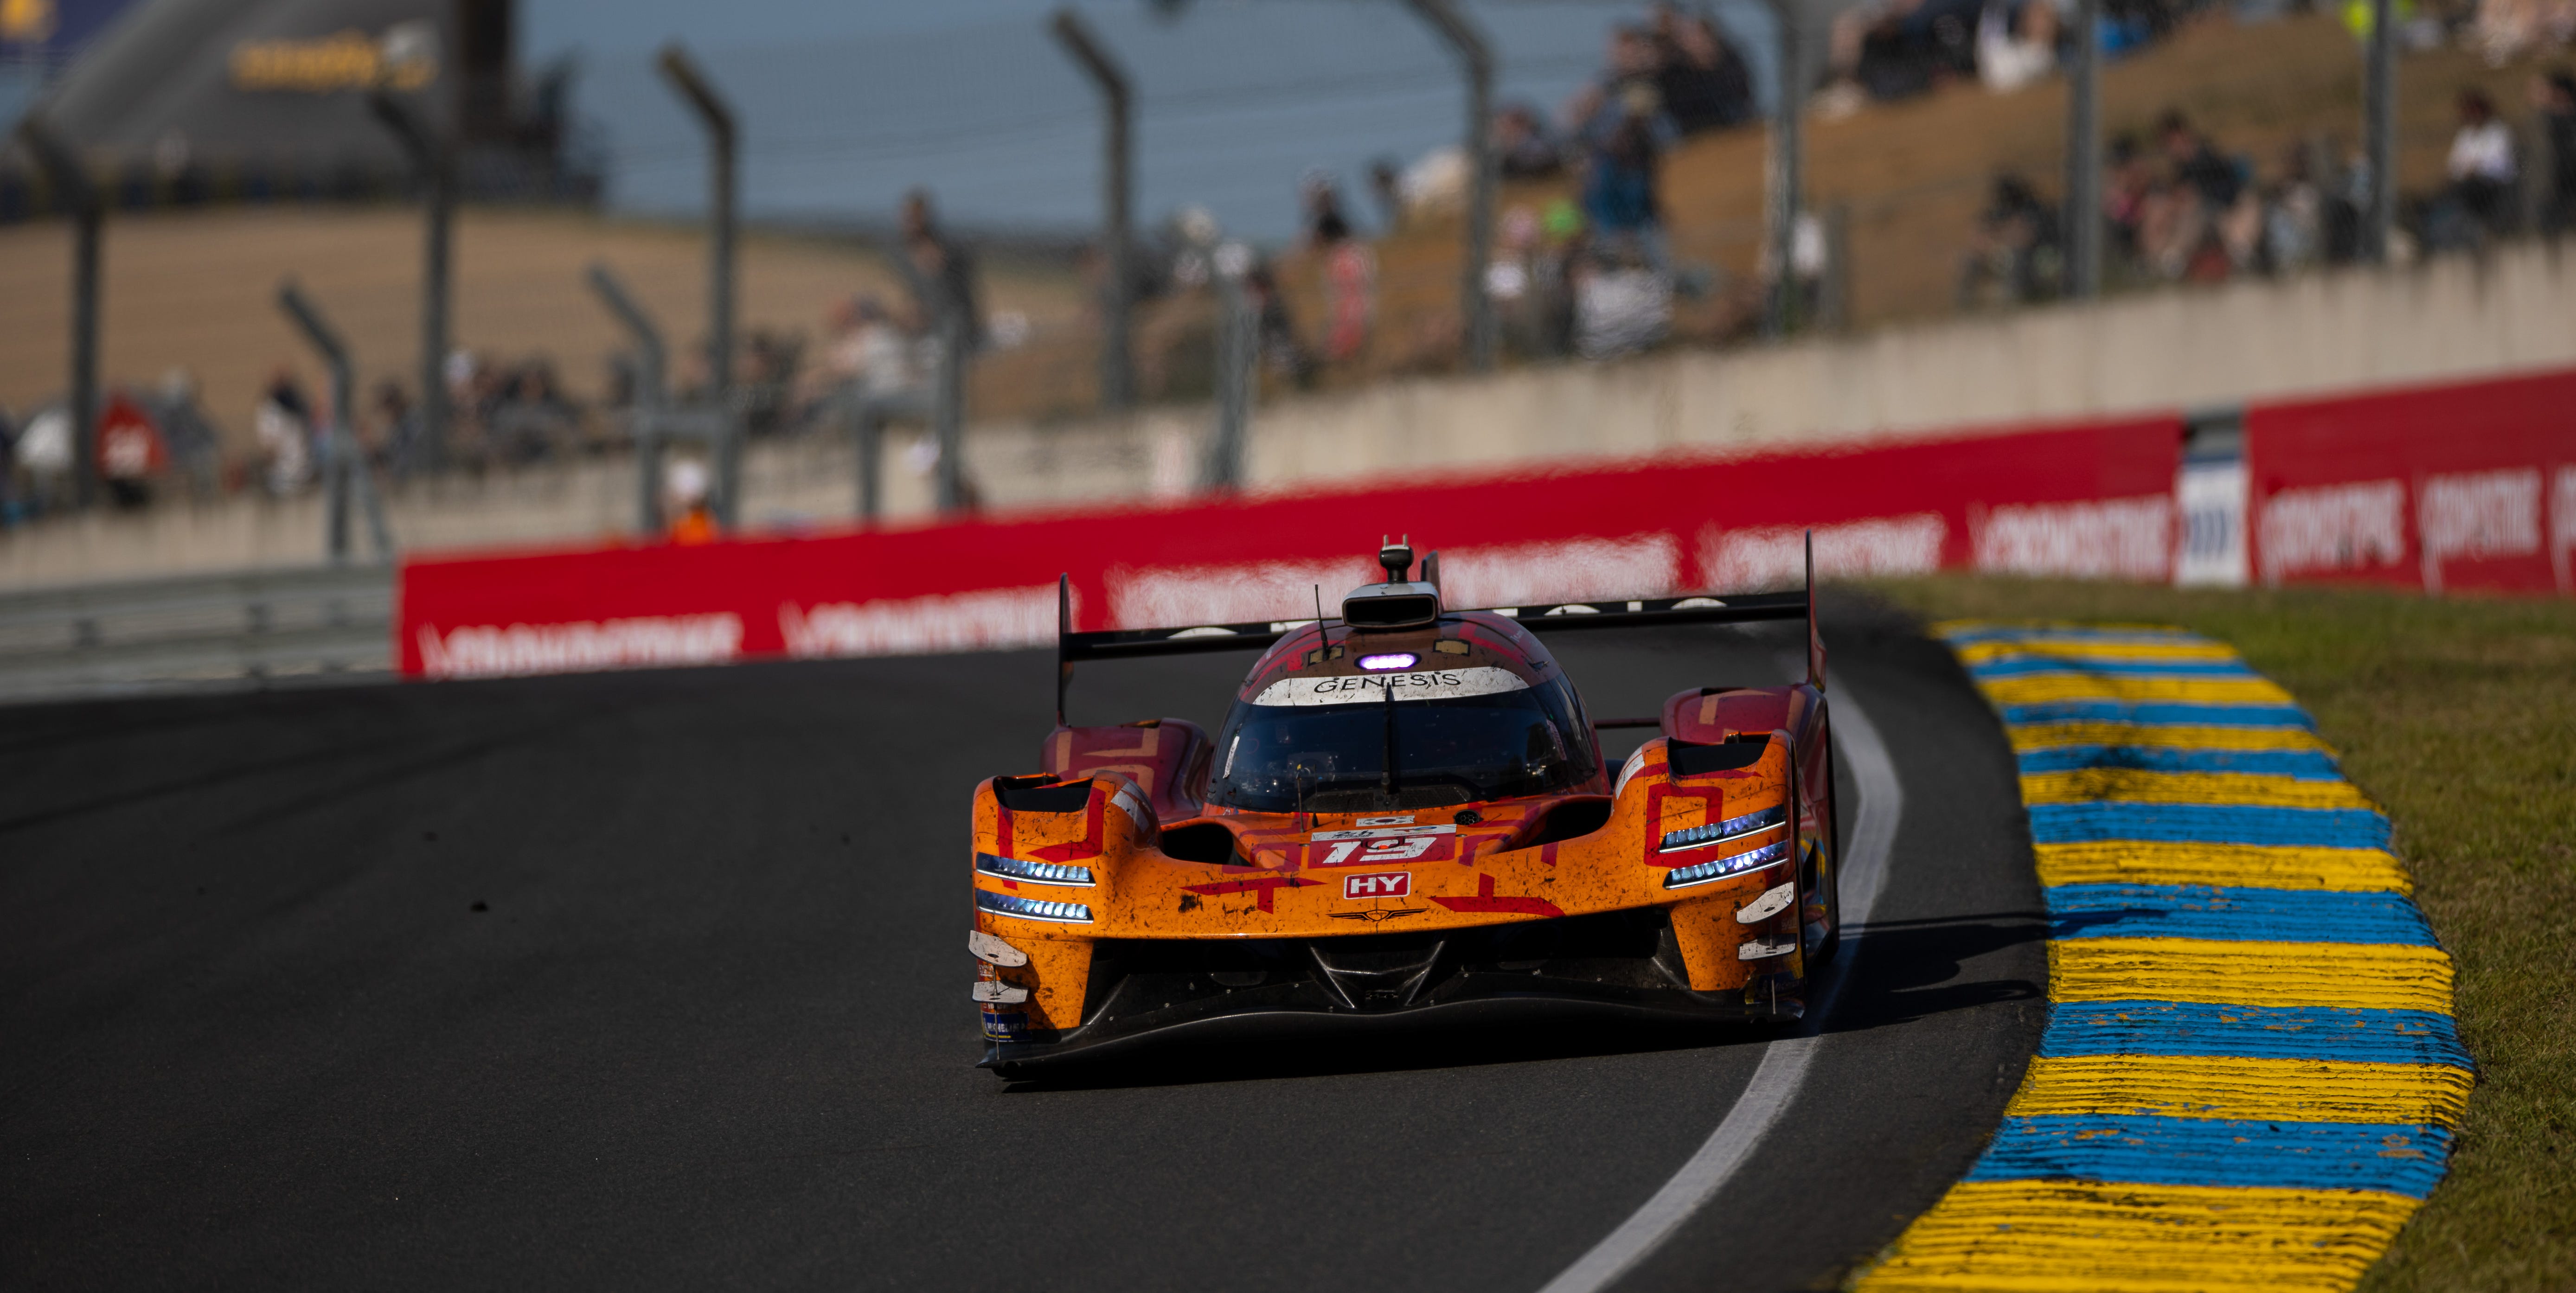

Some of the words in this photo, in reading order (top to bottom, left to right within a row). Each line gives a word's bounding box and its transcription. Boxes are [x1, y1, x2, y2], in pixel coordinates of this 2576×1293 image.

[1314, 673, 1461, 693] GENESIS
[1322, 837, 1437, 864] 19
[1350, 875, 1405, 894] HY
